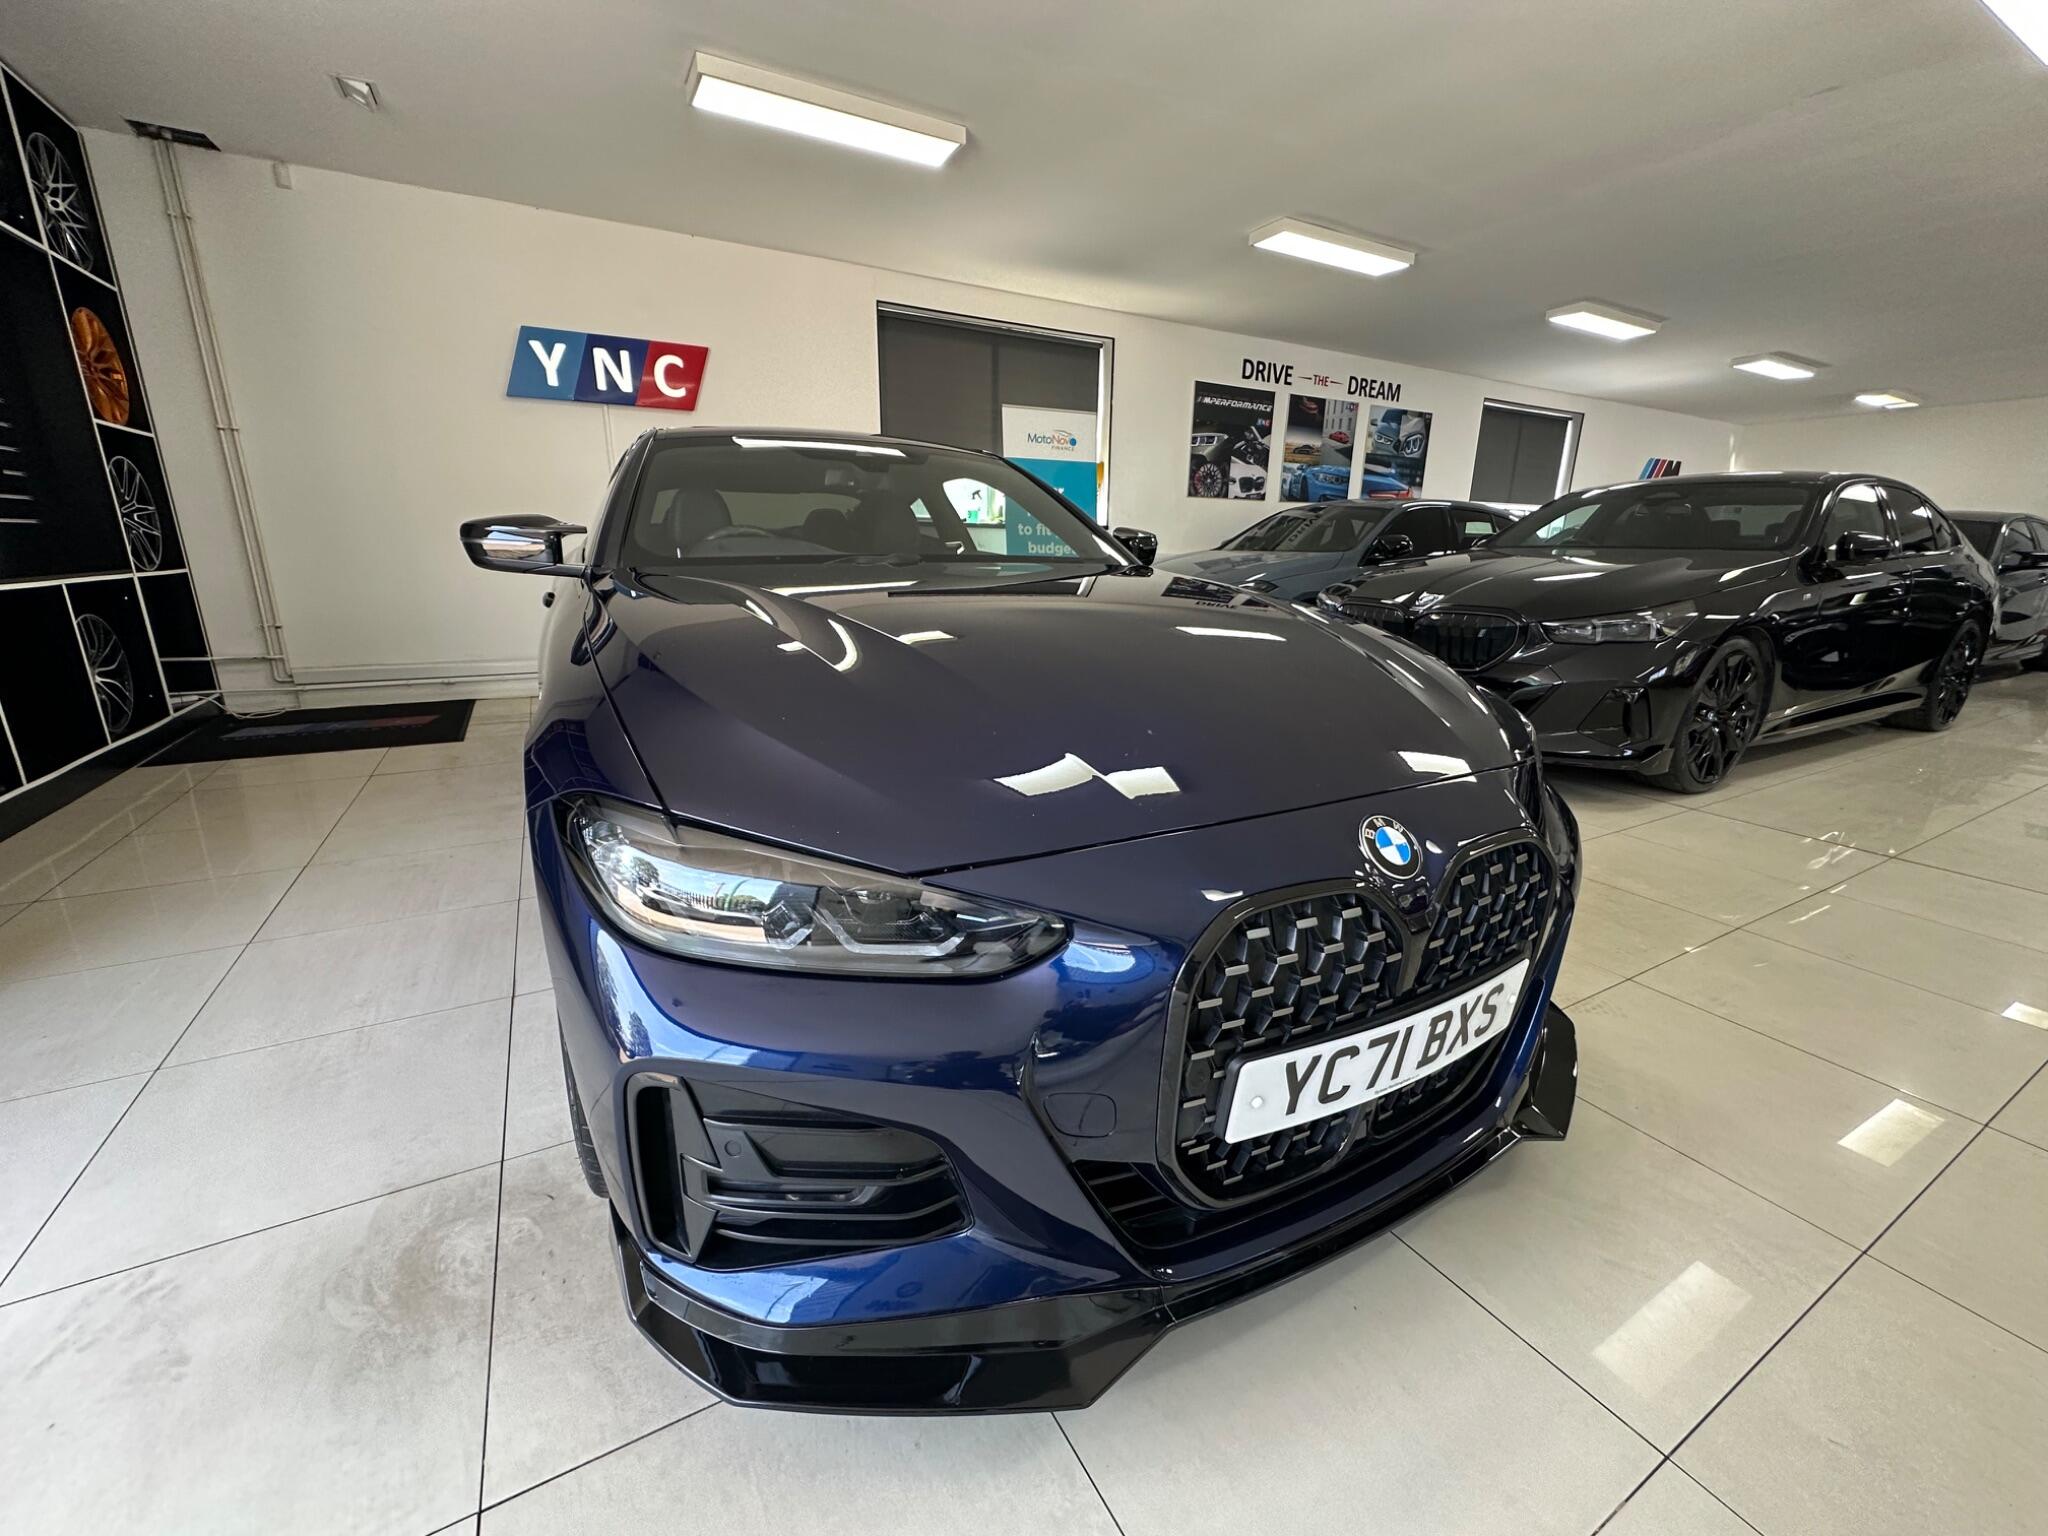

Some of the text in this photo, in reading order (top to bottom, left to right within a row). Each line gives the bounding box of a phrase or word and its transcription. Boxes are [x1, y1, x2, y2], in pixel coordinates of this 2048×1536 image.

[528, 339, 687, 398] YNC
[1242, 358, 1402, 402] DRIVE THE DREAM
[1018, 523, 1033, 535] to
[1364, 818, 1404, 840] BMW
[1415, 982, 1505, 1070] BXS
